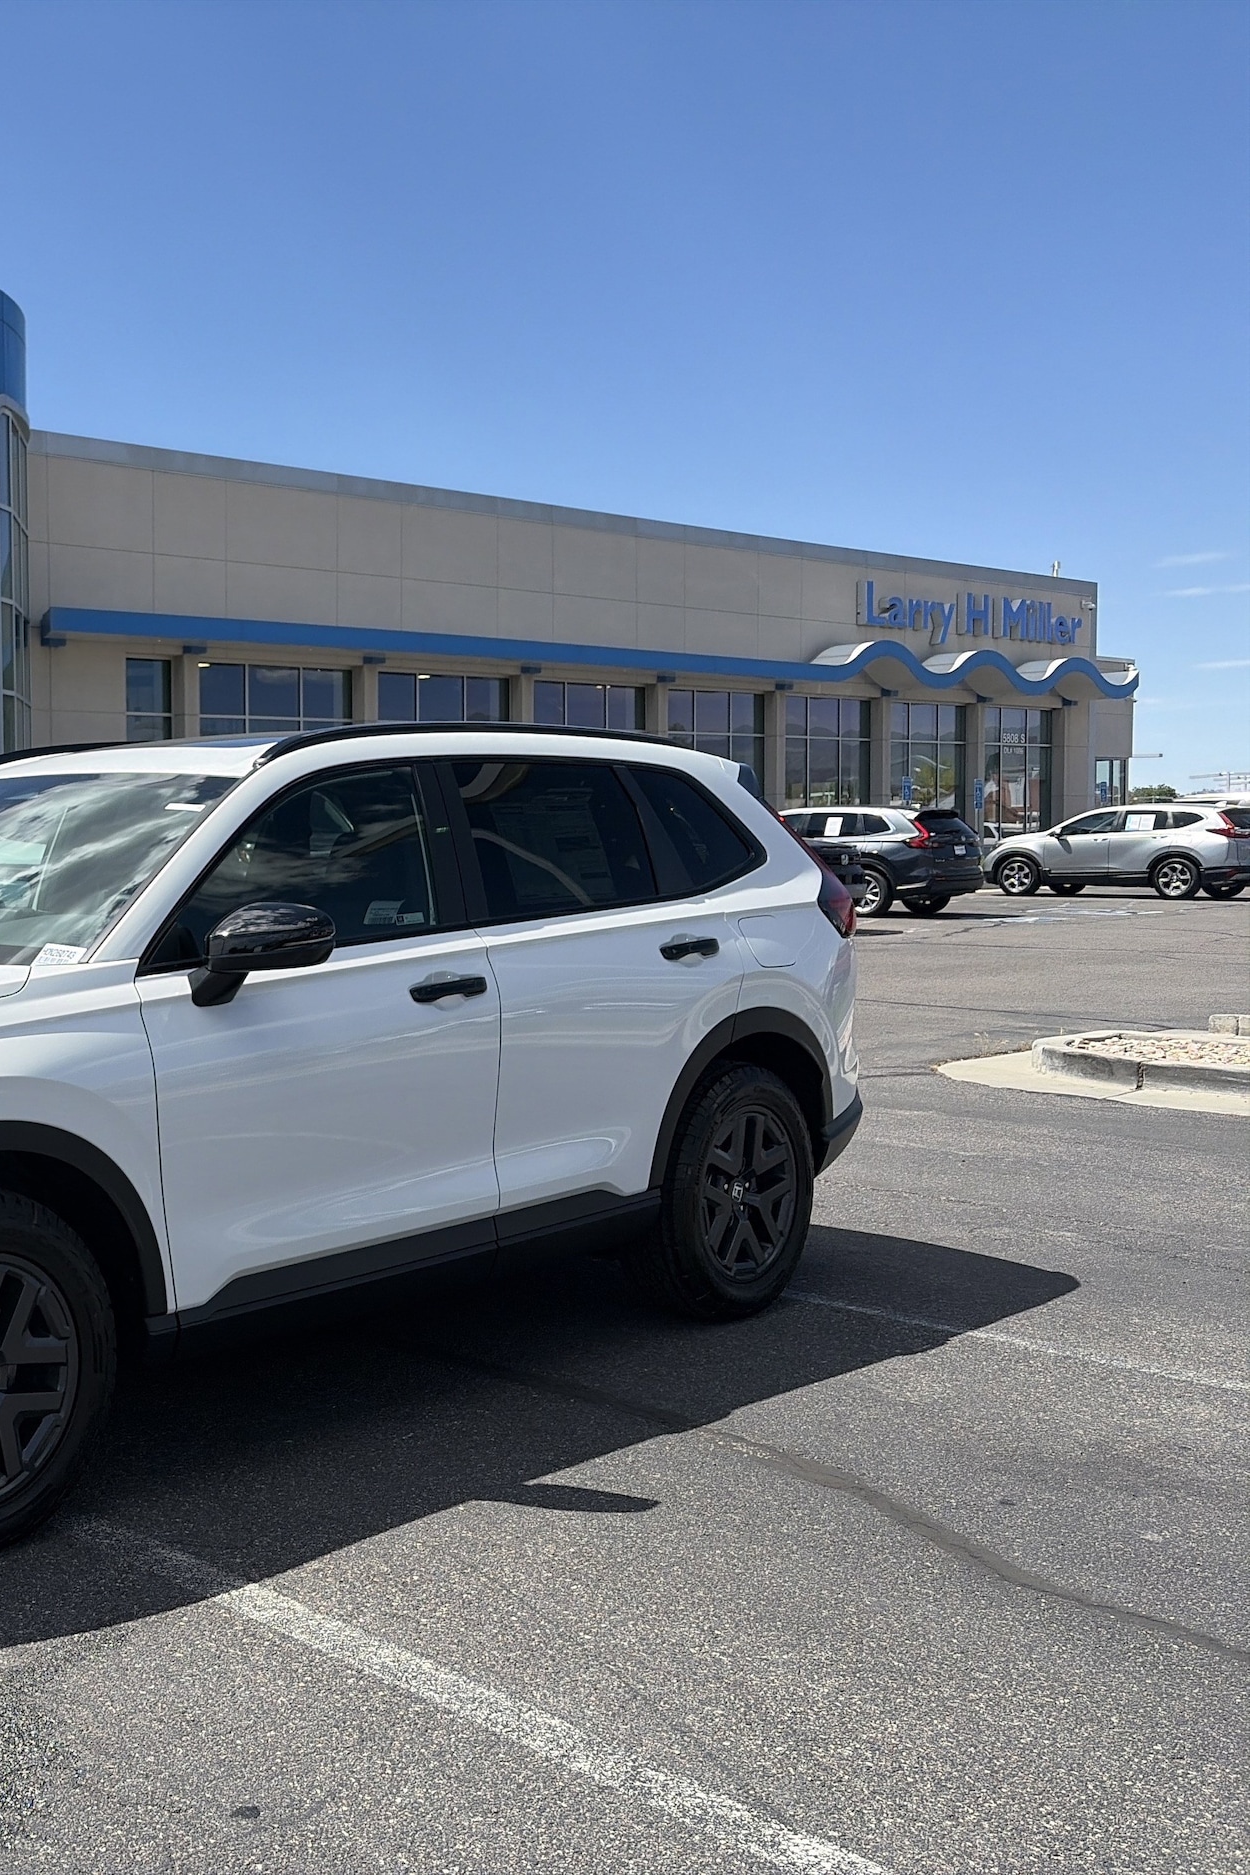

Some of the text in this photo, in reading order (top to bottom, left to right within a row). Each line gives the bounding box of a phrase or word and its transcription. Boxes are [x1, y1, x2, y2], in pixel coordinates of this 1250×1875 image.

[864, 579, 1084, 645] Larry H Miller
[1020, 733, 1026, 744] S
